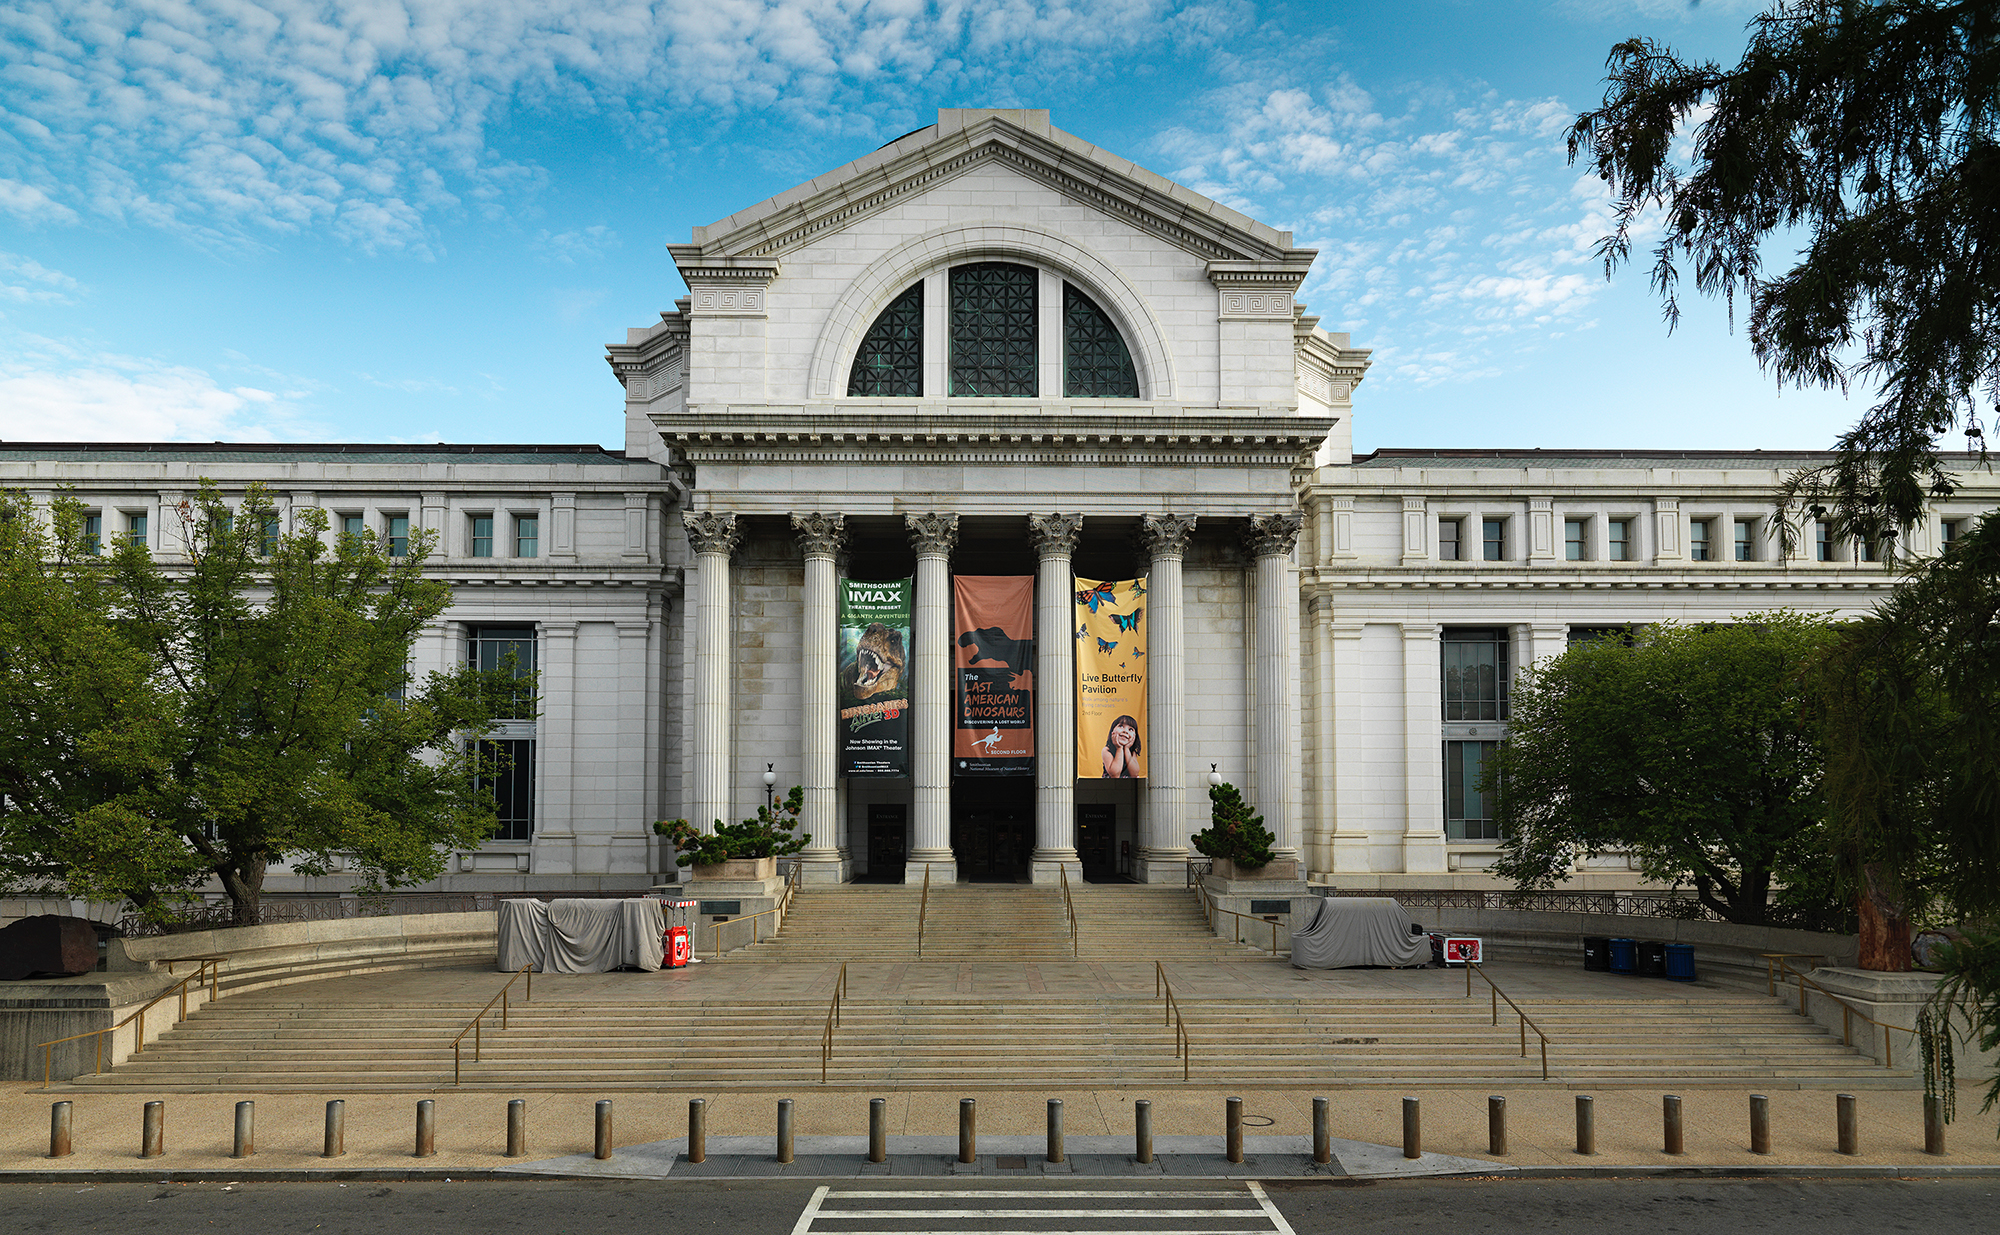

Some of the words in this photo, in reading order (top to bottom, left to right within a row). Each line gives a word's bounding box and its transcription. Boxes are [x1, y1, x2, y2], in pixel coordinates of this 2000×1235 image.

[964, 673, 979, 681] The
[1082, 673, 1100, 682] Live
[1102, 673, 1143, 684] Butterfly
[964, 681, 994, 693] LAST
[1082, 684, 1117, 694] Pavilion
[964, 693, 1019, 706] AMERICAN
[883, 708, 900, 720] 3D
[964, 706, 1025, 719] DINOSAURS
